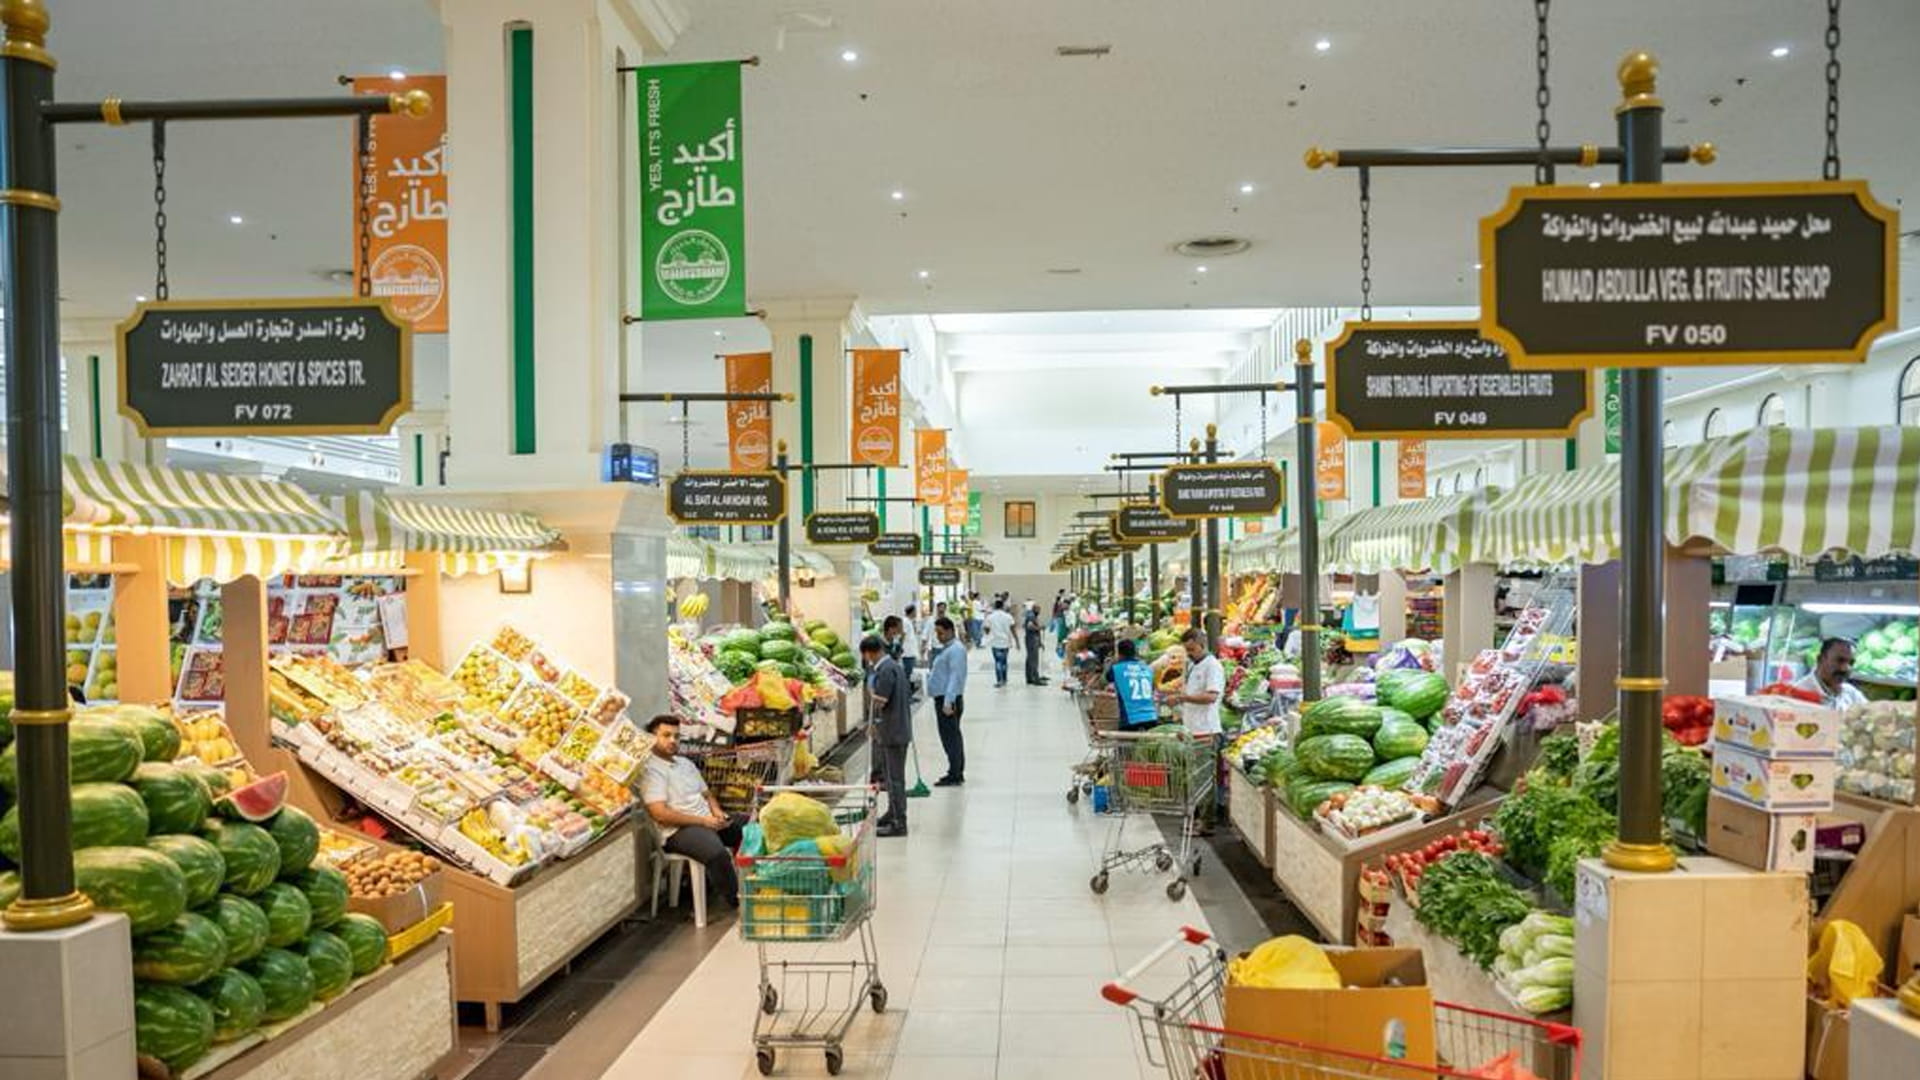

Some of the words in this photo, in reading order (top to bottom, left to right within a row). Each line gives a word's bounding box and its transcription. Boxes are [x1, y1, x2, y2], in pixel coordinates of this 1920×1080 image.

[647, 79, 661, 128] FRESH
[673, 117, 736, 172] أكيد
[648, 159, 662, 192] YES,
[372, 187, 452, 238] طازج
[657, 174, 736, 226] طازج
[1600, 213, 1670, 242] الخضروات
[1673, 215, 1703, 244] لبيع
[1707, 210, 1758, 240] عبدالله
[1761, 216, 1798, 240] حميد
[1801, 213, 1831, 238] محل
[1542, 268, 1595, 302] HUMAID
[1596, 267, 1659, 302] ABDULLA
[1659, 267, 1691, 301] VEG.
[1693, 266, 1704, 300] &
[1705, 266, 1753, 300] FRUITS
[1754, 265, 1791, 300] SALE
[1792, 265, 1831, 300] SHOP
[160, 319, 215, 344] والبهارات
[217, 320, 254, 343] العسل
[256, 318, 294, 343] لتجارة
[296, 320, 332, 342] السدر
[334, 316, 366, 341] زهرة
[1645, 324, 1679, 345] FV
[1684, 323, 1727, 345] 050
[161, 361, 203, 389] ZAHRAT
[204, 361, 219, 389] AL
[220, 361, 257, 388] SEDER
[258, 360, 295, 388] HONEY
[297, 360, 305, 387] &
[306, 359, 347, 387] SPICES
[346, 359, 367, 387] TR.
[235, 404, 258, 420] FV
[261, 404, 293, 420] 072
[1434, 411, 1456, 426] FV
[1459, 411, 1487, 426] 049
[1128, 677, 1153, 701] 20
